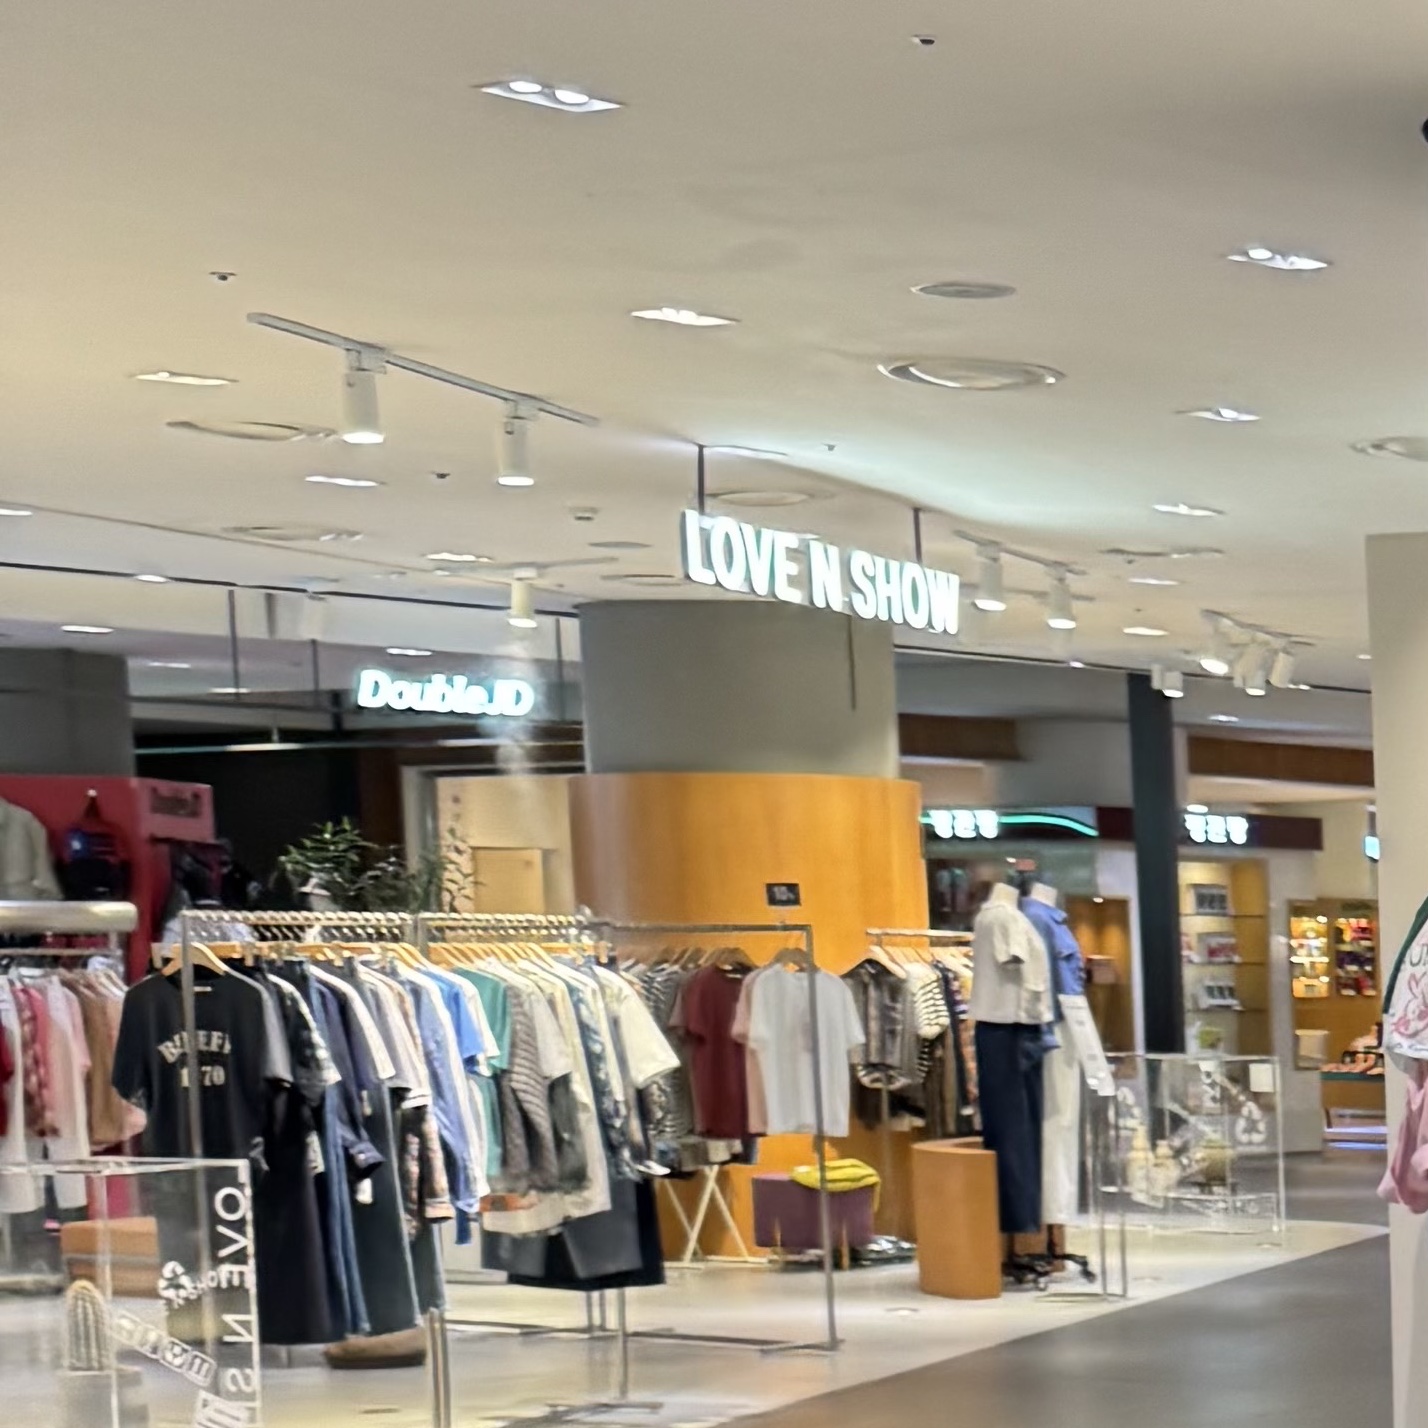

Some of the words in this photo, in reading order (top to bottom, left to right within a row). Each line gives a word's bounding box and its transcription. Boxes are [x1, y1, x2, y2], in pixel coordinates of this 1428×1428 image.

[682, 508, 803, 605] LOVE
[809, 539, 844, 613] N
[850, 549, 961, 636] SHOW
[181, 1065, 226, 1088] 170
